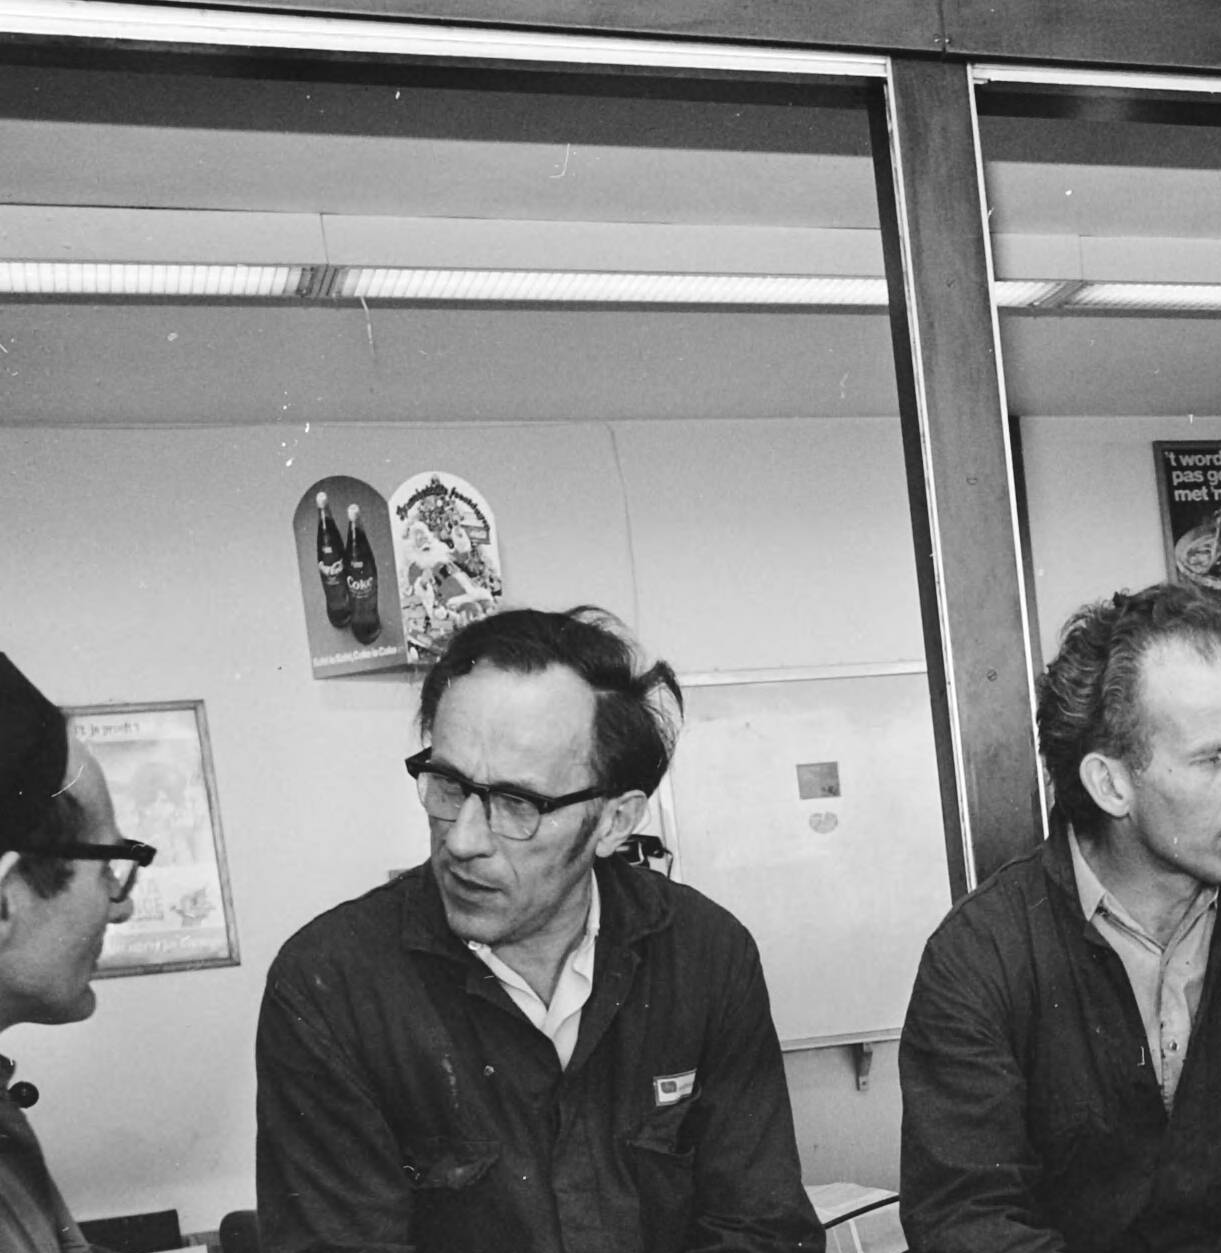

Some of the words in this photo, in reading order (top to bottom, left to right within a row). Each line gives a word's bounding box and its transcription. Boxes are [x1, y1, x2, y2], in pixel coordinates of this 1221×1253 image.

[1164, 451, 1177, 466] 't
[1172, 470, 1204, 486] pas
[1174, 485, 1209, 501] met
